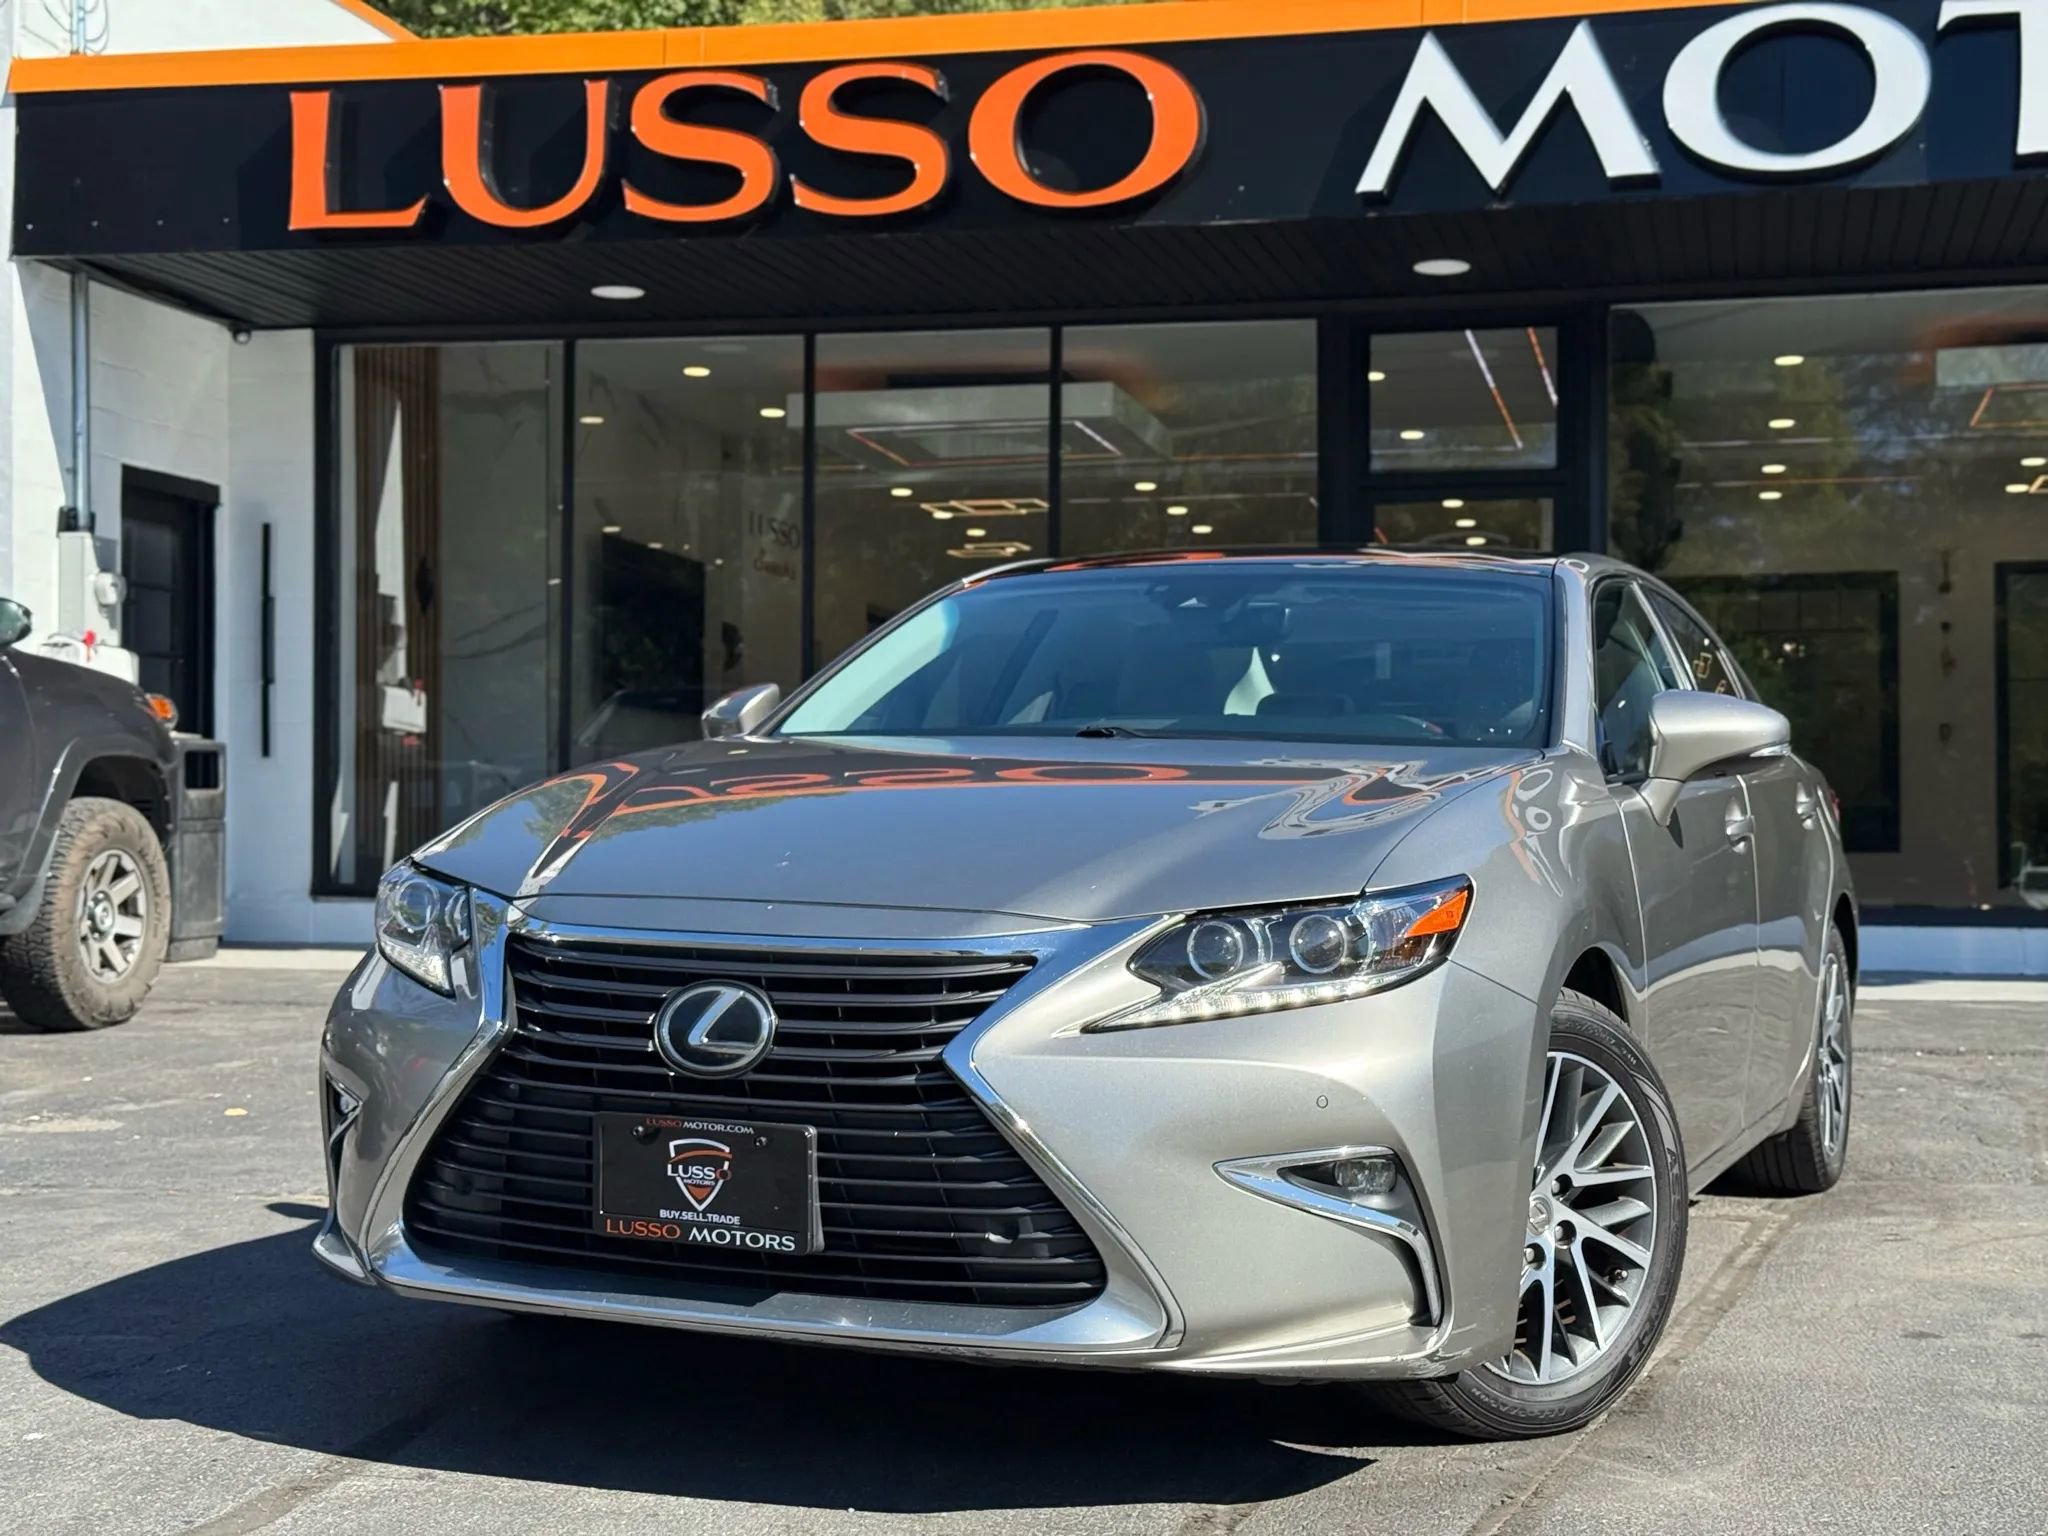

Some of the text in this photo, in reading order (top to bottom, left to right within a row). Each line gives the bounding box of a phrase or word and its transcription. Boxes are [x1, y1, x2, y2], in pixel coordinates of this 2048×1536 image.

[288, 49, 1204, 231] LUSSO
[667, 1163, 732, 1181] LUSSO
[683, 1178, 716, 1187] MOTORS
[606, 1218, 796, 1251] LUSSO MOTORS
